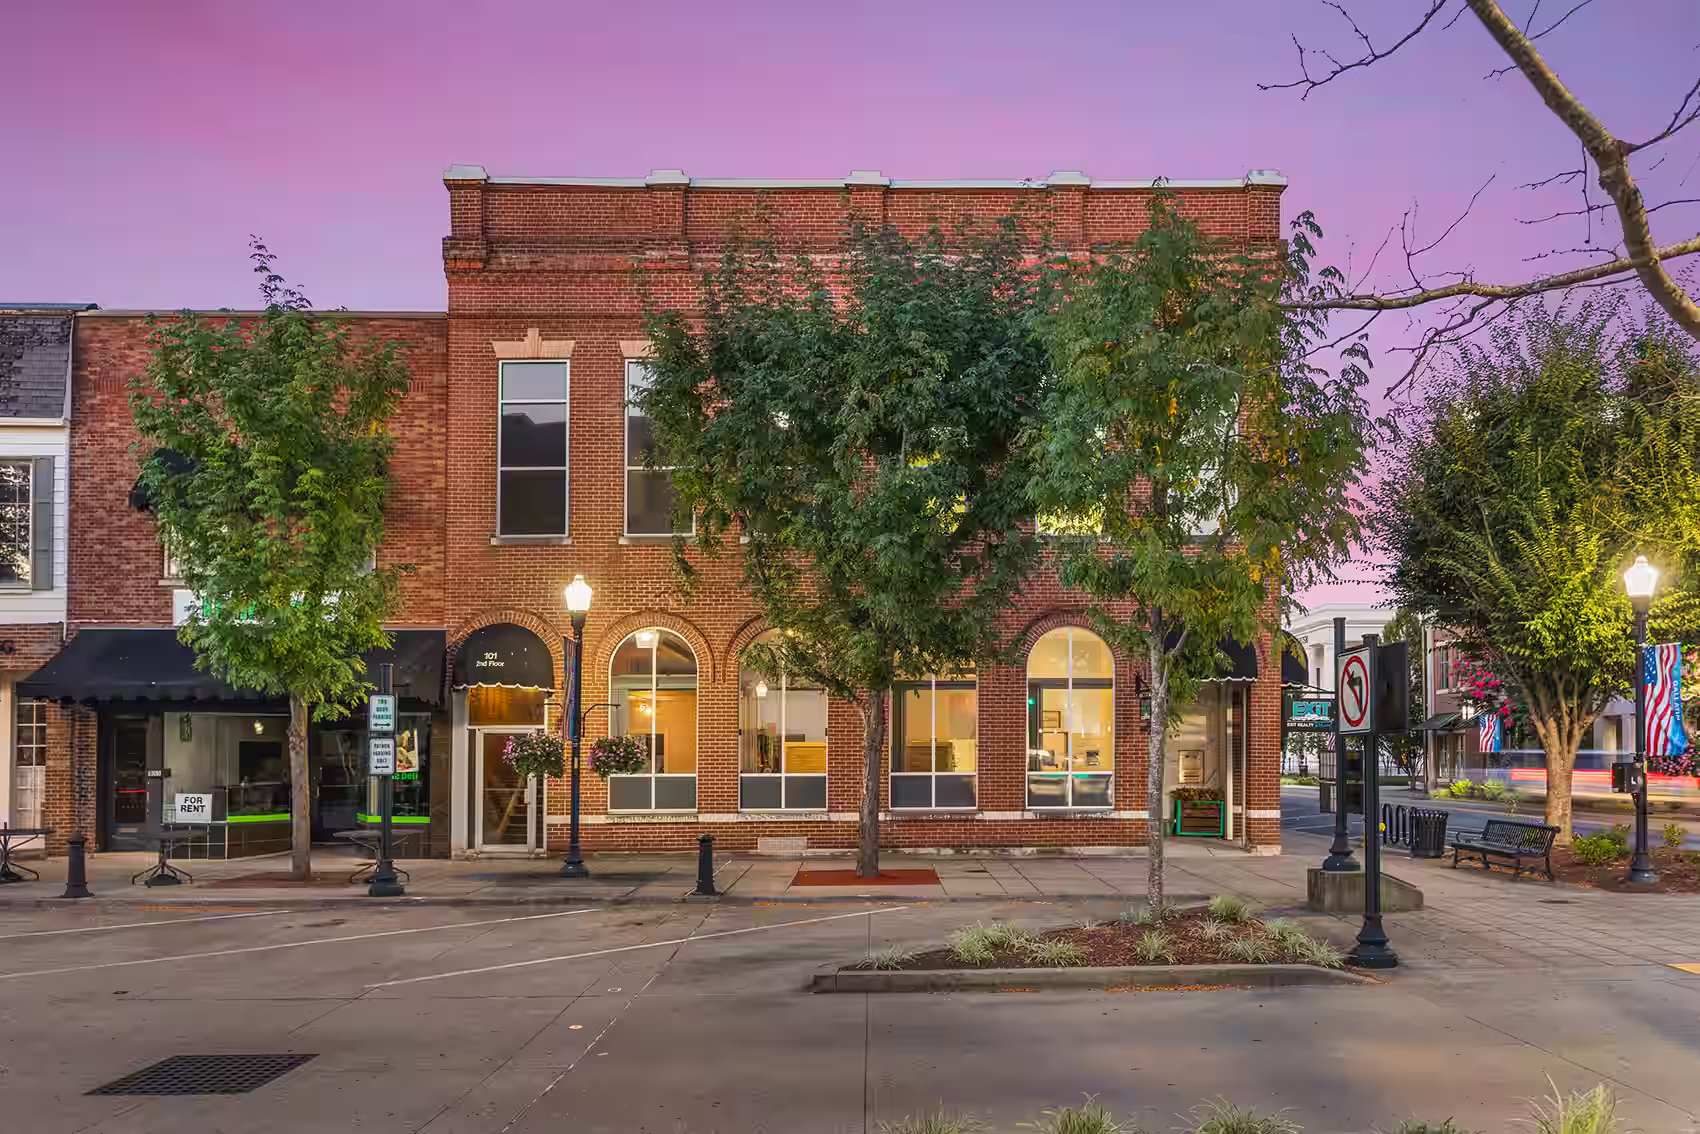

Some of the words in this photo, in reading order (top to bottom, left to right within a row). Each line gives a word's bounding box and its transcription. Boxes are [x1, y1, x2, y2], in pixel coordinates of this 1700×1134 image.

[484, 652, 498, 660] 101
[1672, 680, 1681, 721] GALLATIN
[1292, 701, 1332, 717] EXIT
[180, 804, 206, 813] RENT
